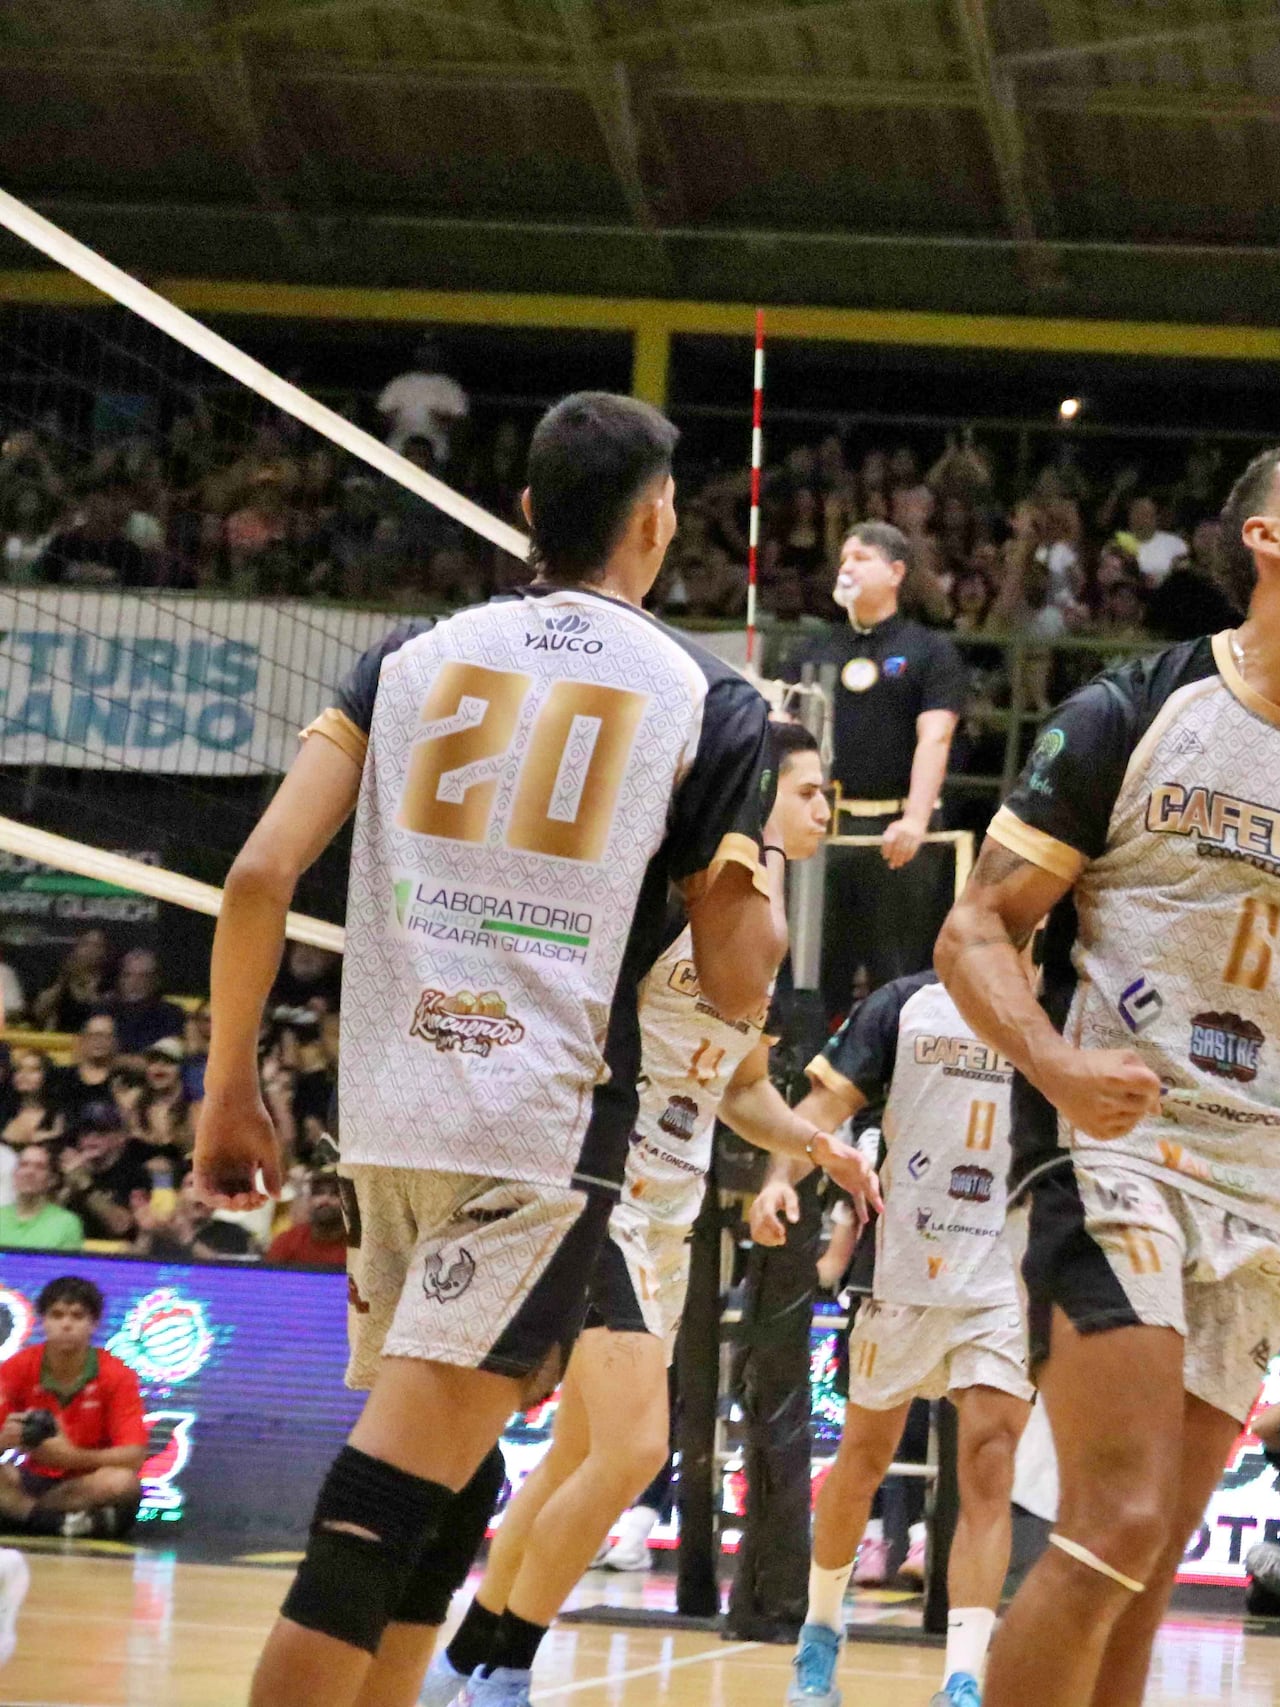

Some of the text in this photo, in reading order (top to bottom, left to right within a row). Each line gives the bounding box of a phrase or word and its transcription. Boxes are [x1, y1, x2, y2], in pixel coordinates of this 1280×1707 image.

[524, 632, 603, 654] YAUCO
[397, 661, 650, 864] 20
[416, 883, 593, 934] LABORATORIO
[408, 914, 588, 965] IRIZARRY GUASCH
[1191, 1024, 1263, 1069] SASTRE
